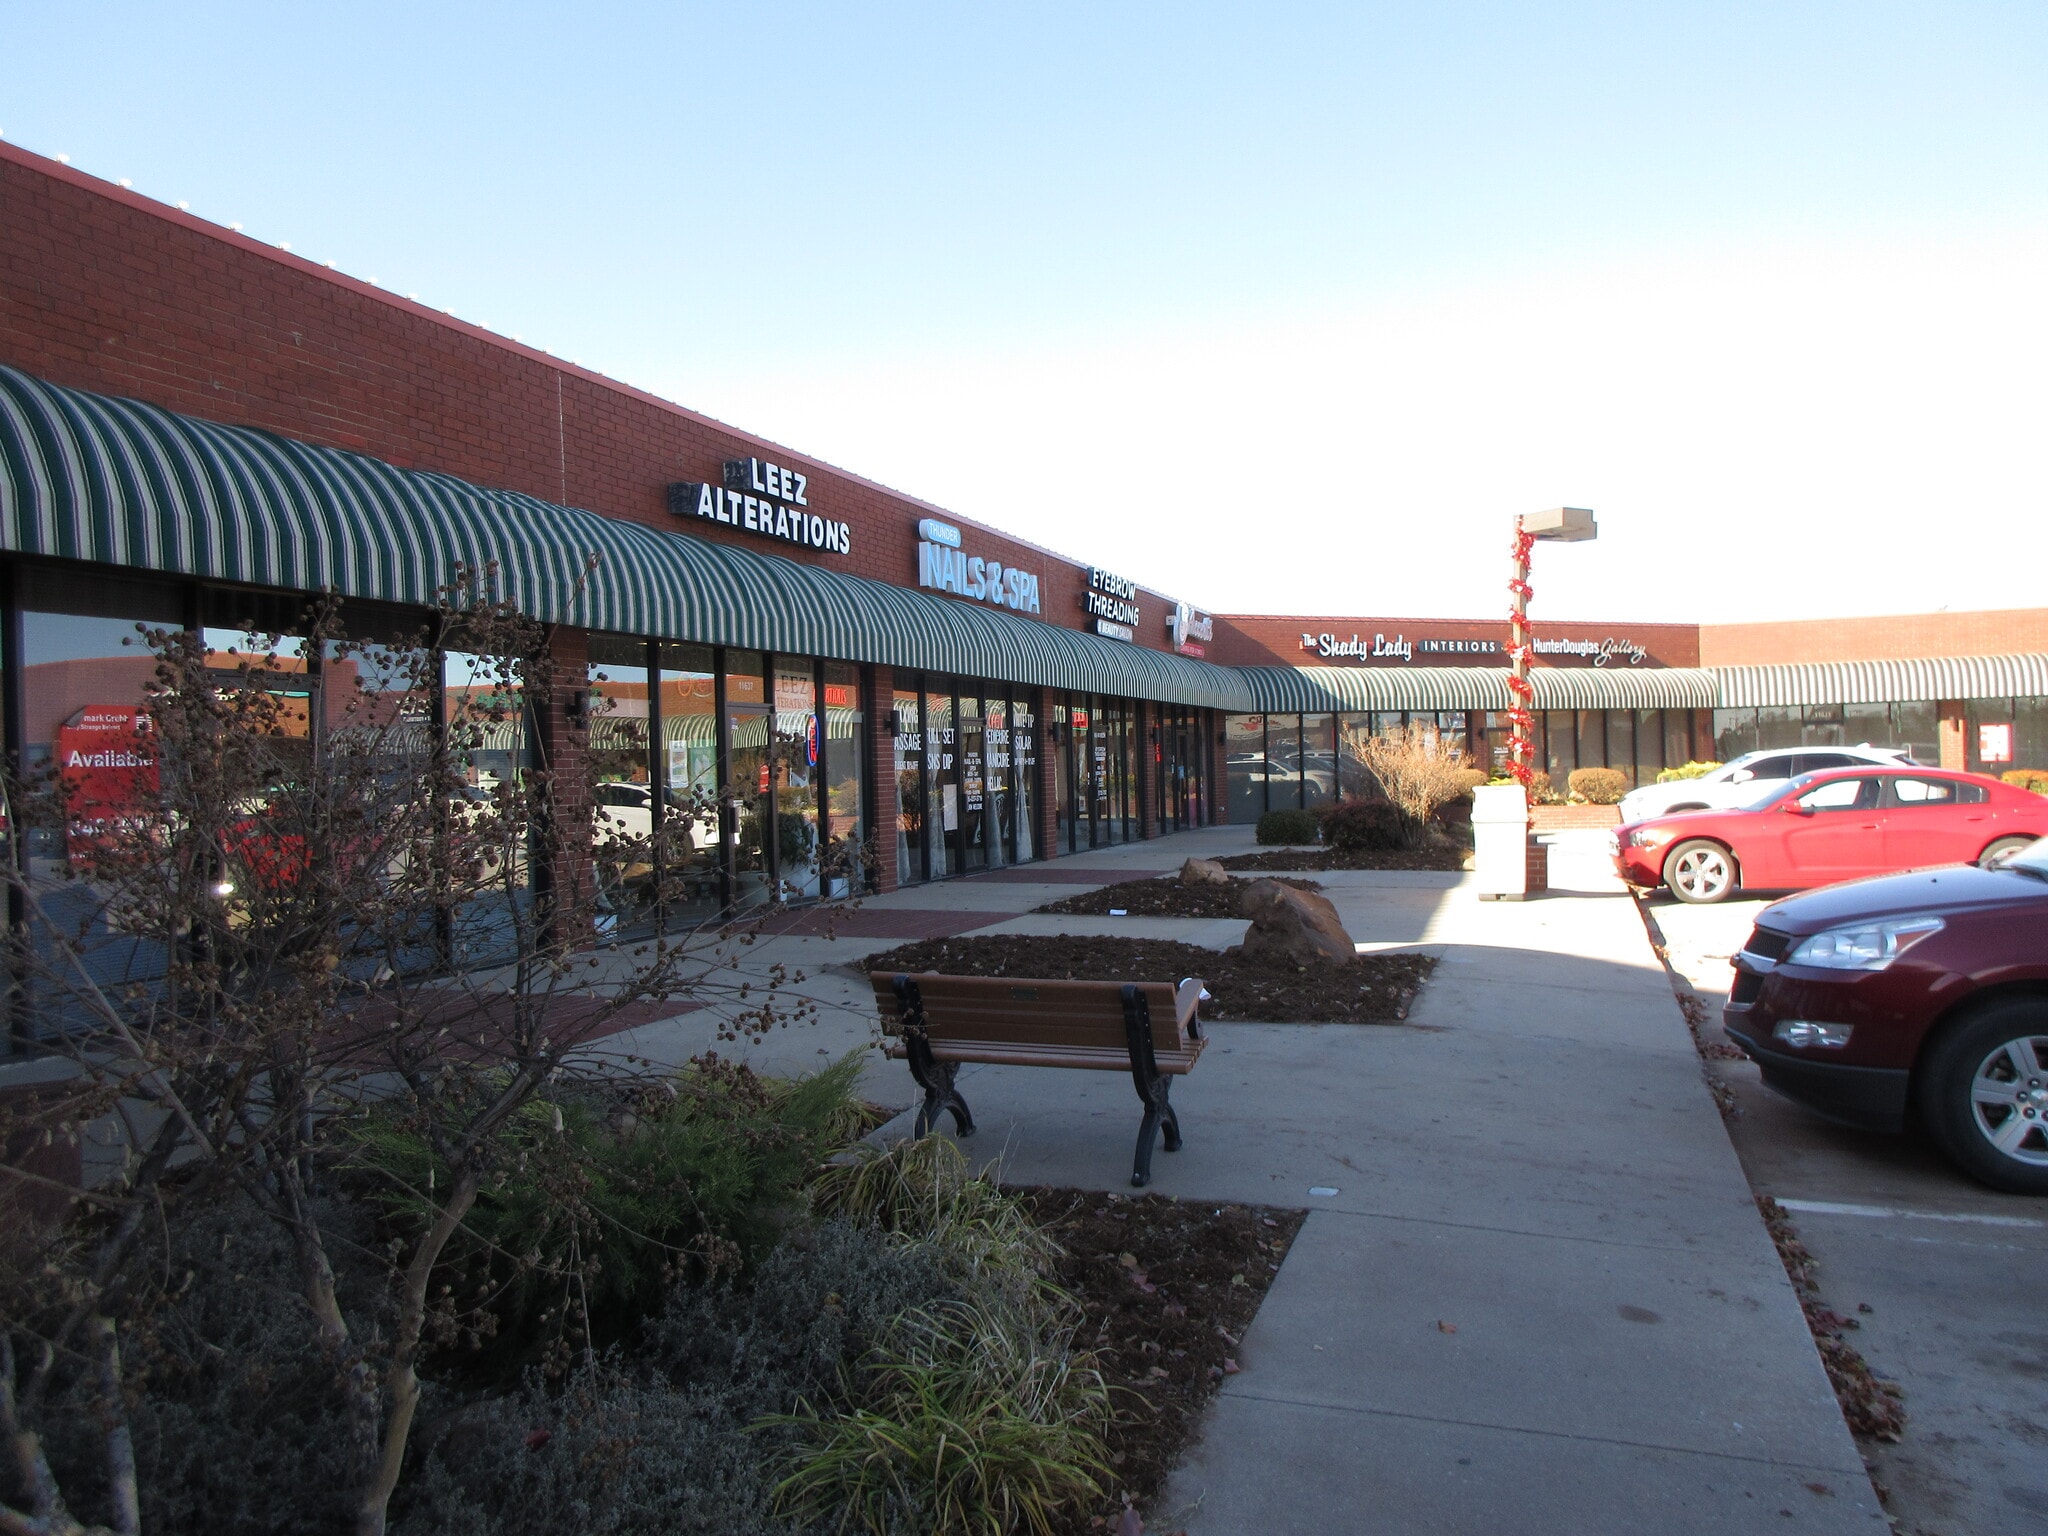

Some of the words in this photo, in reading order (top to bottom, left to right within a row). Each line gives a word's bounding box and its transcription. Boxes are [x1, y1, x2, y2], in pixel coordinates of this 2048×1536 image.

[751, 457, 808, 506] LEEZ
[697, 483, 851, 554] ALTERATIONS
[929, 522, 959, 543] THUNDER
[922, 541, 987, 601] NAILS
[1005, 567, 1040, 615] SPA
[1092, 567, 1137, 602] EYEBROW
[1088, 591, 1140, 627] THREADING
[1302, 633, 1318, 648] The
[1319, 633, 1368, 661] Shady
[1372, 633, 1414, 661] Lady
[1423, 640, 1497, 652] INTERIORS
[1594, 638, 1647, 667] Gallery
[775, 675, 808, 695] EEZ
[894, 733, 921, 751] ASSAGE
[943, 728, 954, 745] SET
[1015, 736, 1032, 750] SOLAR
